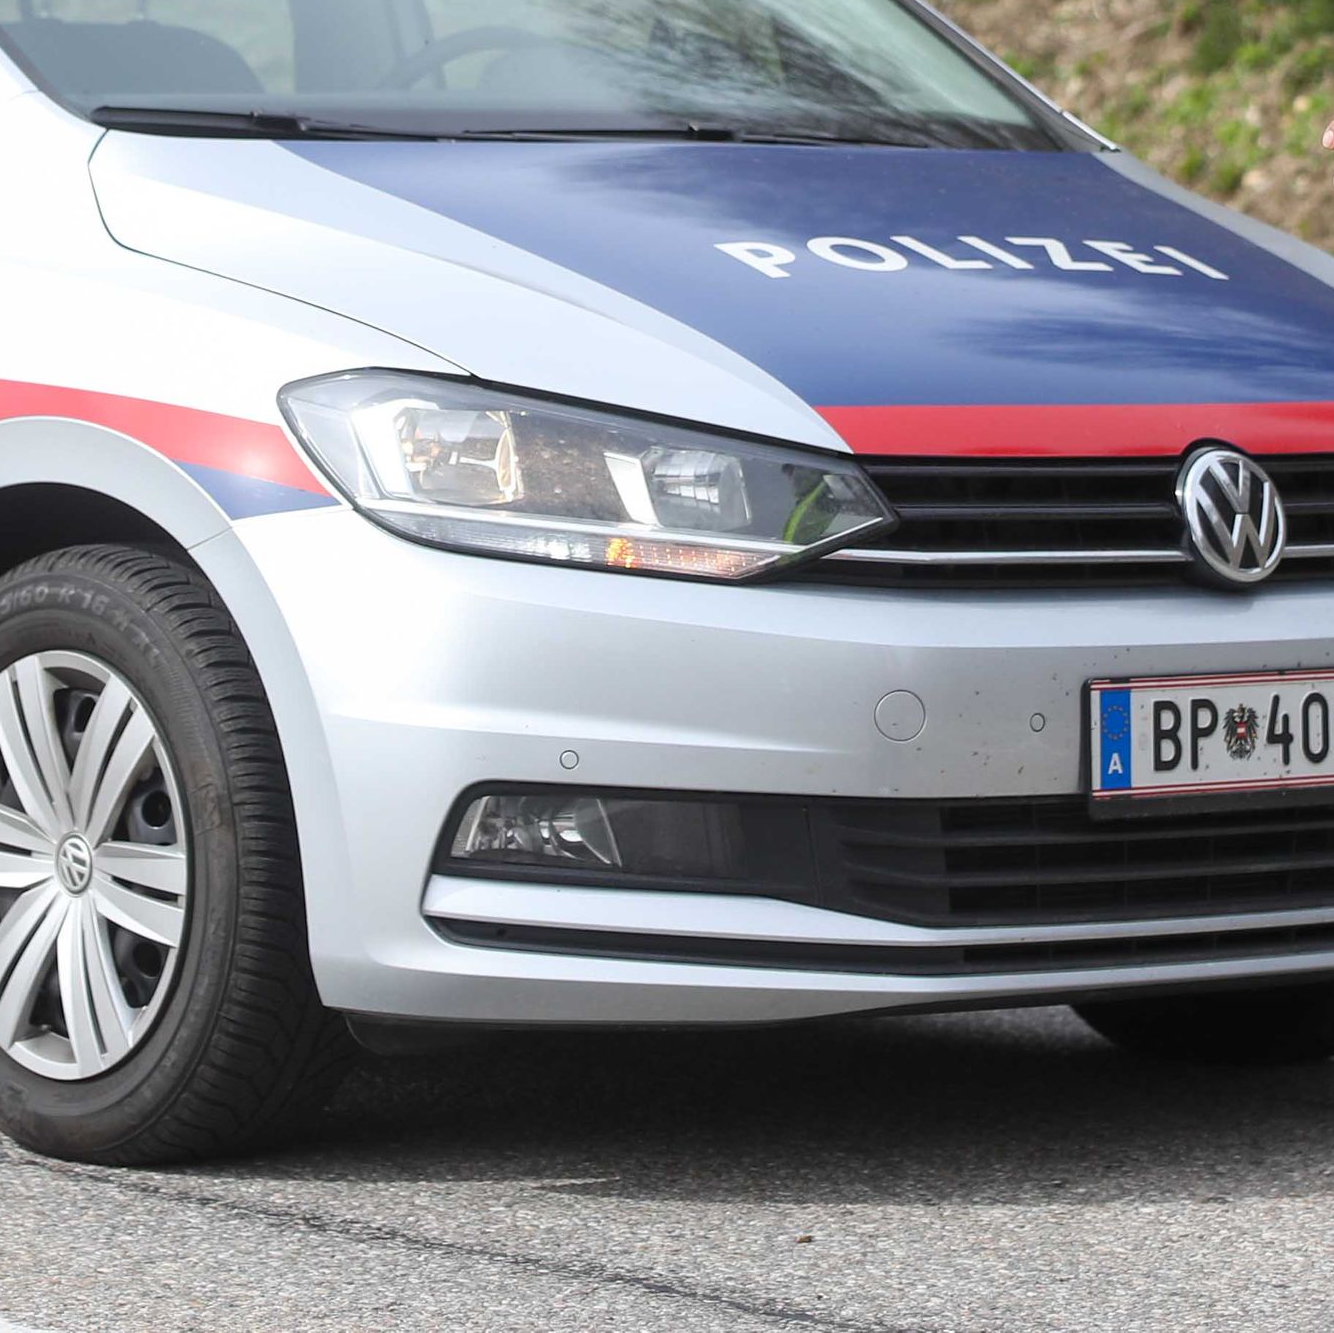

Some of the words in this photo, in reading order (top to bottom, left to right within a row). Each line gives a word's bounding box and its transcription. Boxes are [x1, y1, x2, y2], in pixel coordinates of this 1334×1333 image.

[714, 236, 1229, 280] POLIZEI
[1189, 453, 1282, 577] VW
[1107, 753, 1124, 775] A
[1152, 698, 1219, 772] BP
